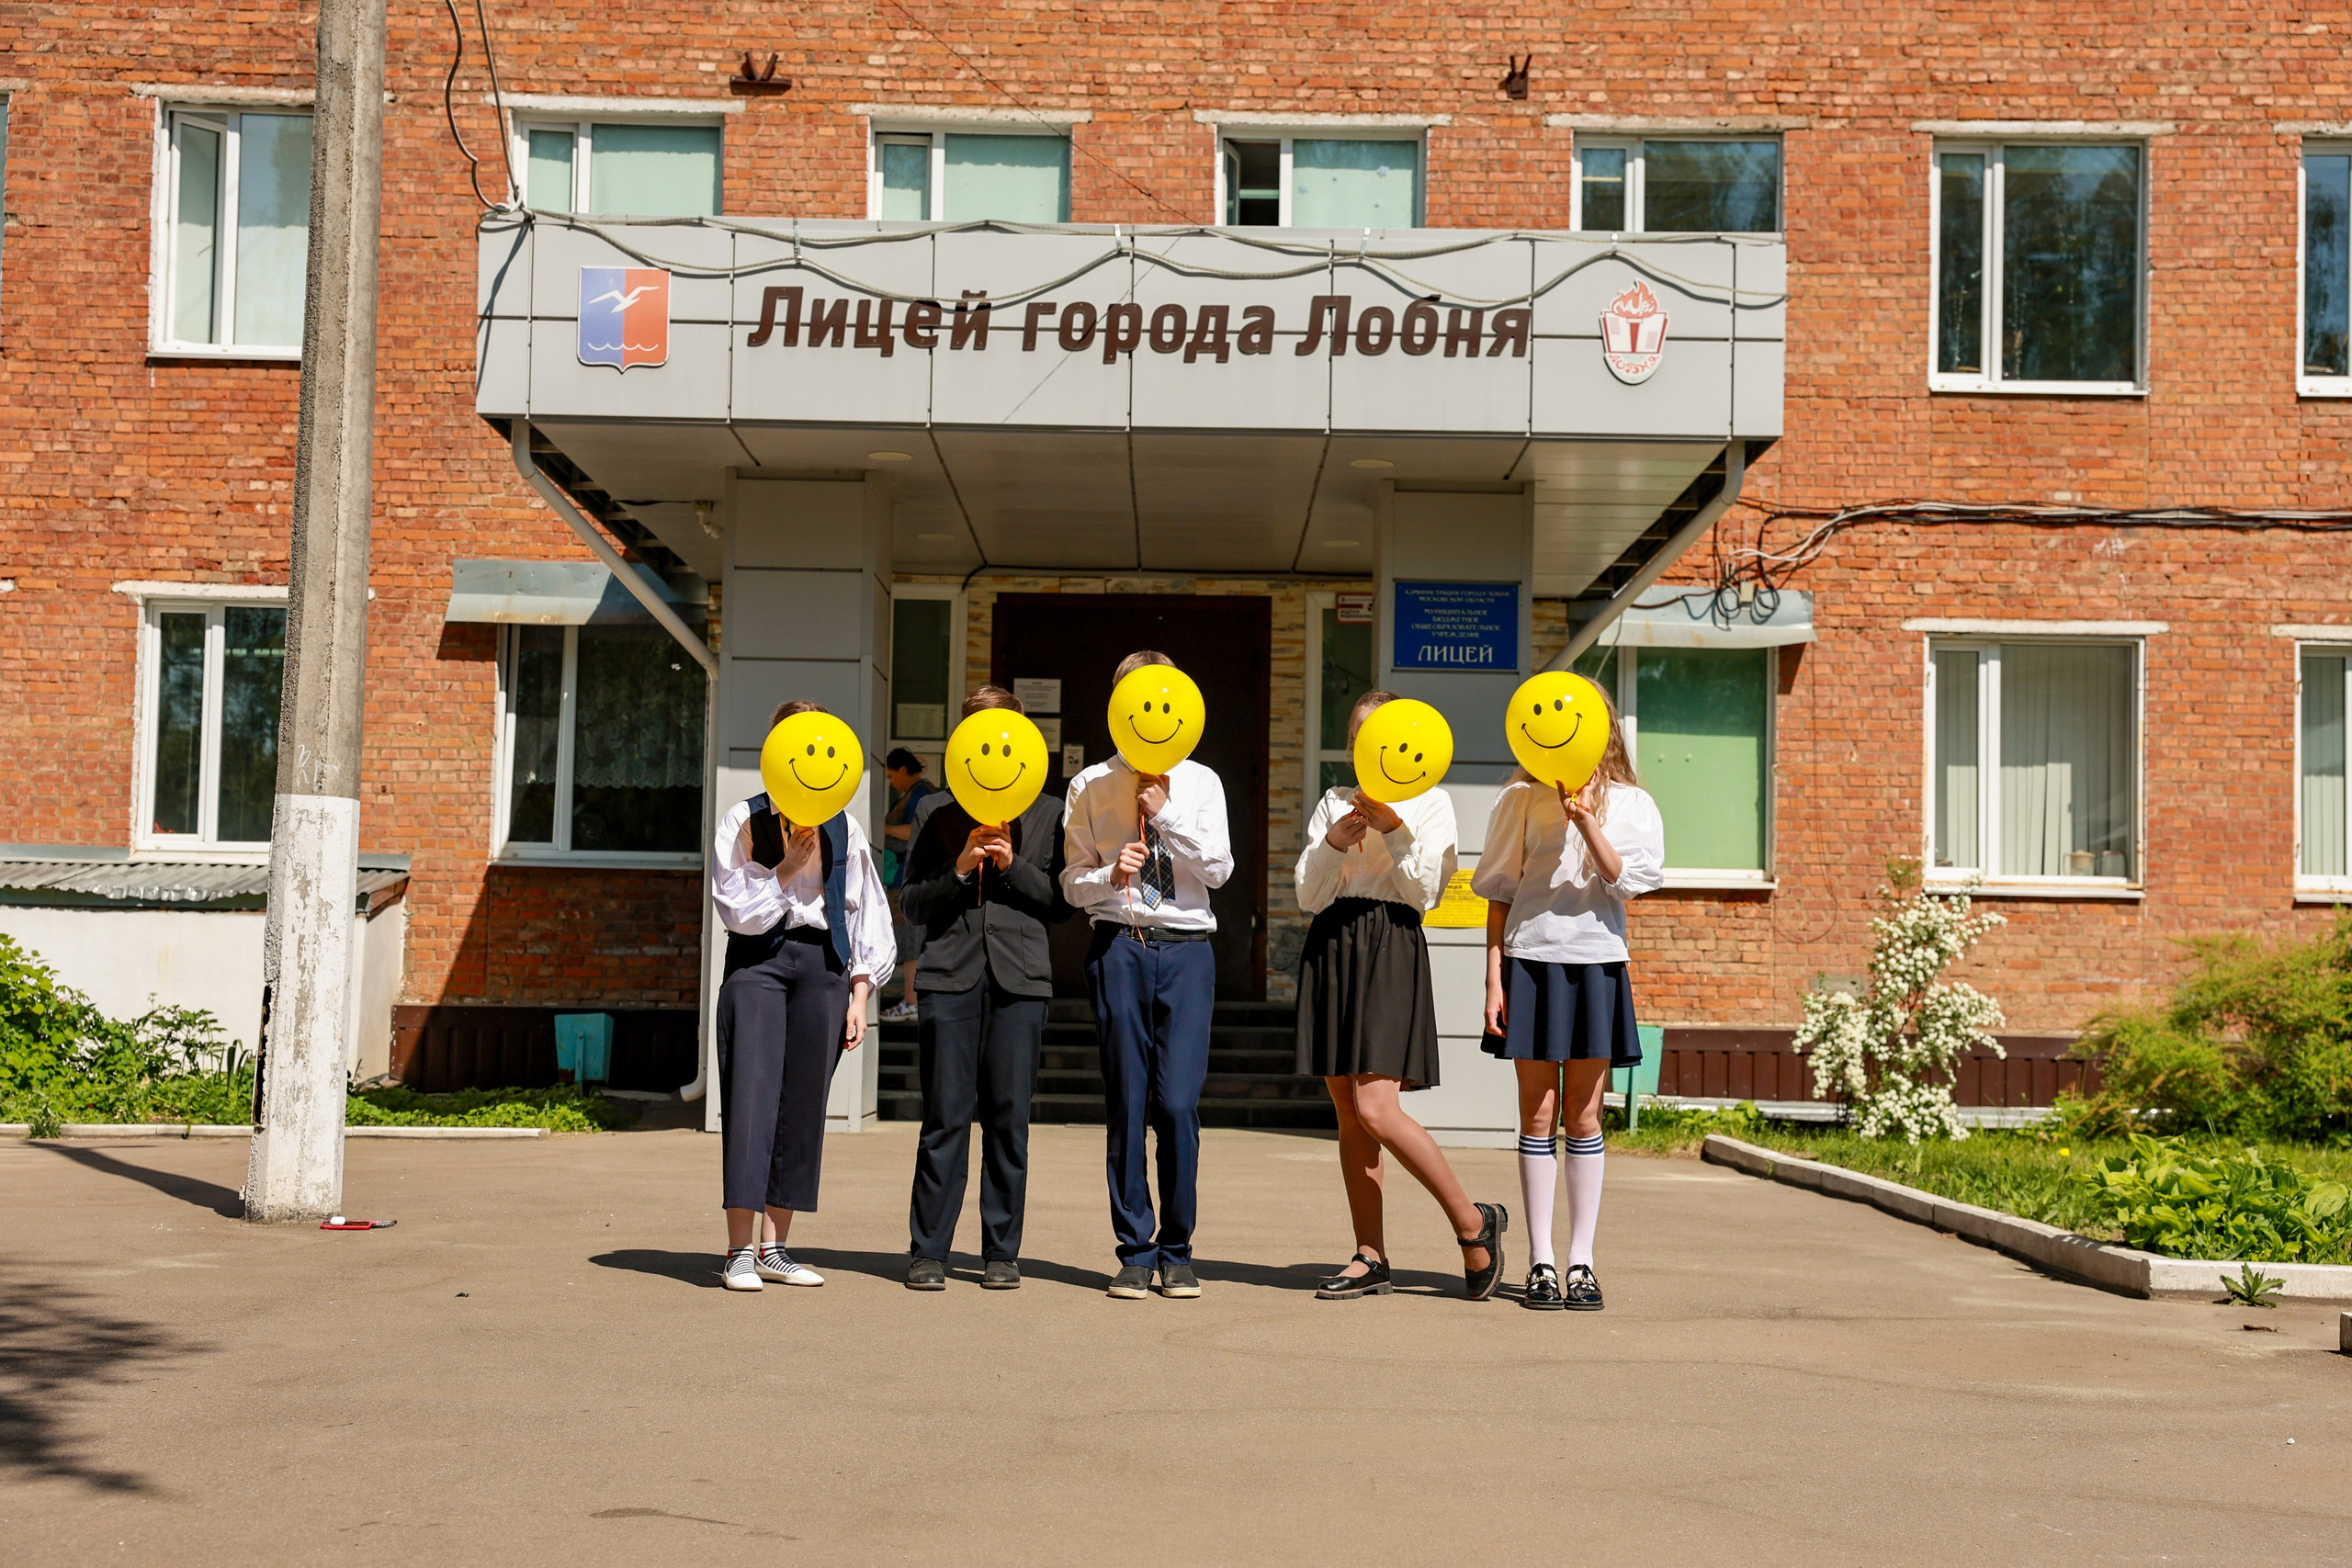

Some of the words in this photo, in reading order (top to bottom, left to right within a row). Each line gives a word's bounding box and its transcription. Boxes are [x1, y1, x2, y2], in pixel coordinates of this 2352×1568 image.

[748, 287, 991, 357] Лицей
[1022, 301, 1276, 365] города
[1295, 294, 1532, 357] Лобня
[1418, 644, 1493, 664] ЛИЦЕЙ
